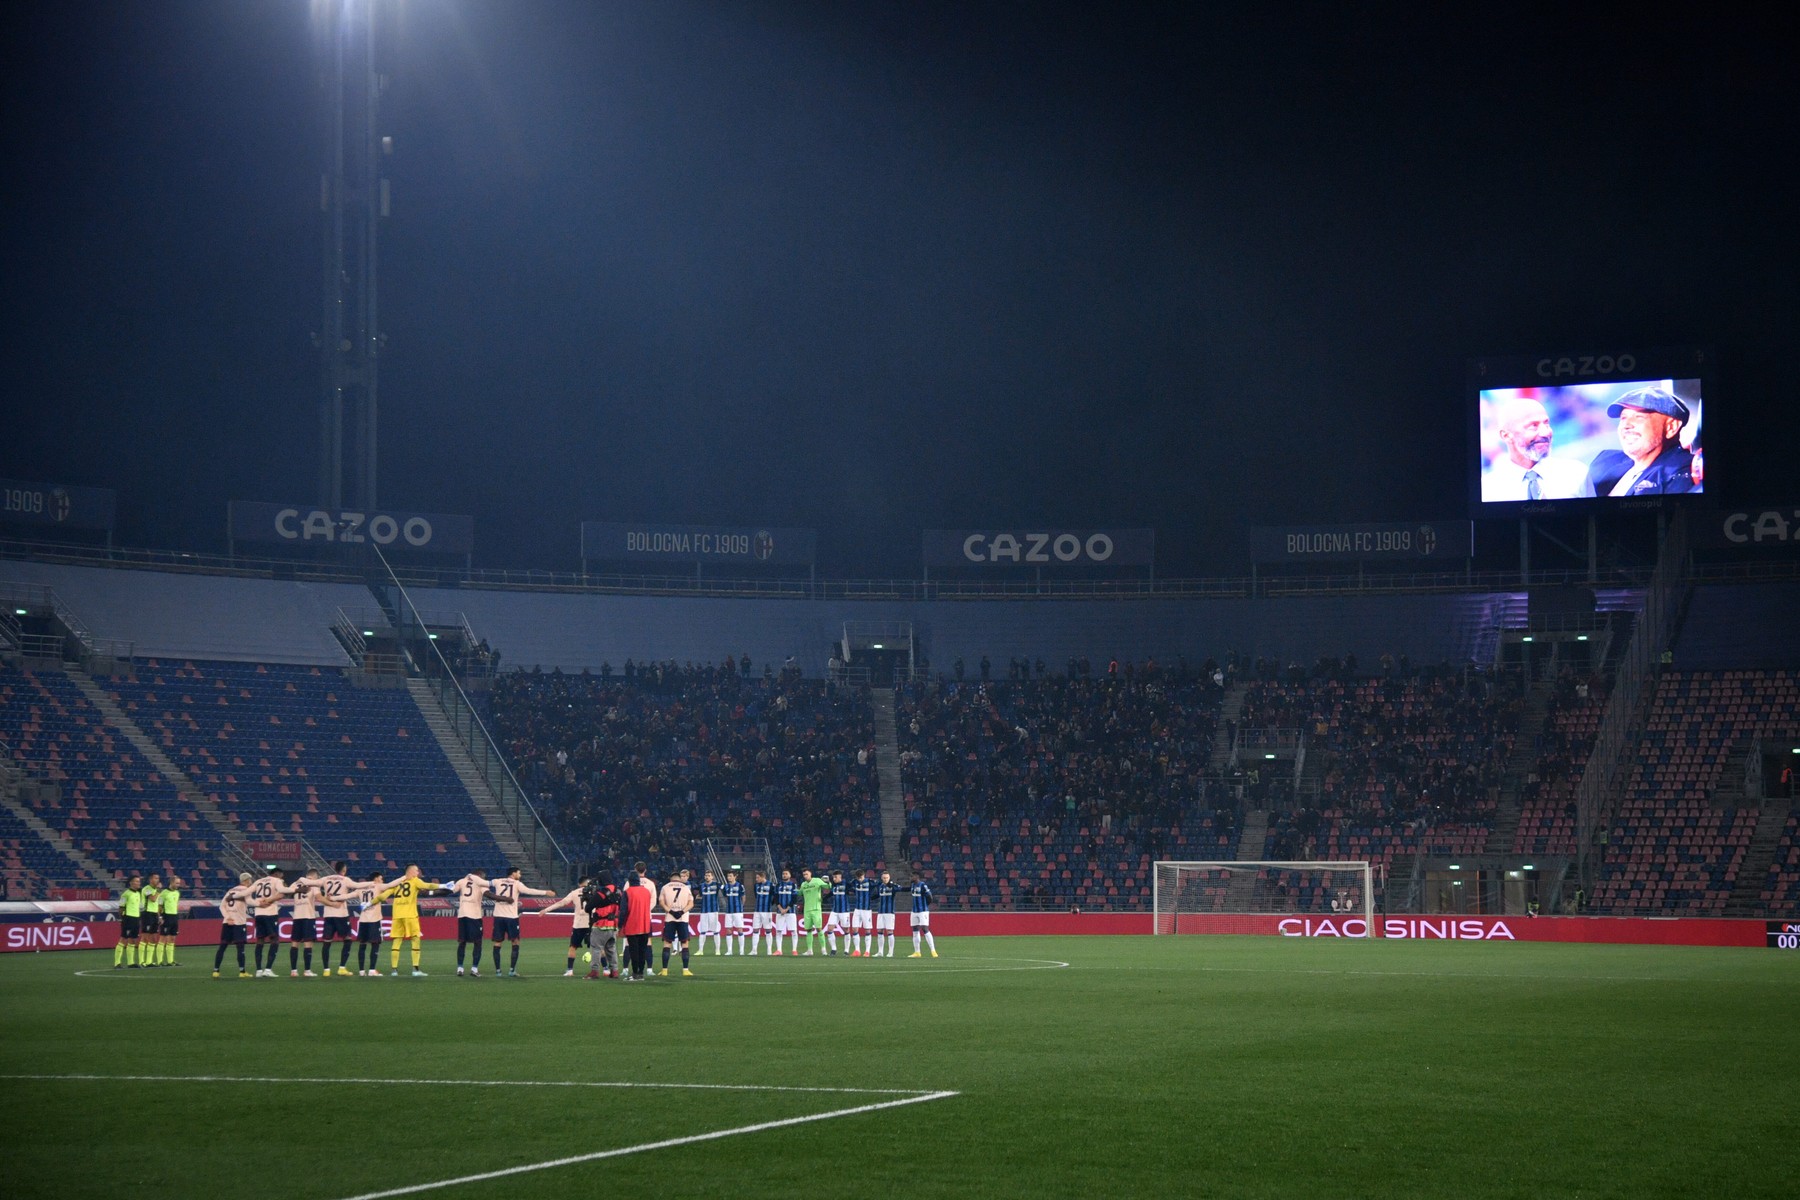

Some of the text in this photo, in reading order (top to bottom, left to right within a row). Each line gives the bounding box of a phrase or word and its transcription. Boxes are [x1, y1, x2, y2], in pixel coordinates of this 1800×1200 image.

[1536, 354, 1636, 377] CAZOO
[4, 488, 43, 513] 1909
[275, 509, 432, 546] CAZOO
[1723, 510, 1800, 542] CA
[627, 532, 749, 554] BOLOGNA FC 1909
[963, 533, 1114, 562] CAZOO
[1287, 531, 1411, 553] BOLOGNA FC 1909
[257, 882, 272, 898] 26
[326, 880, 342, 896] 22
[394, 882, 411, 898] 28
[464, 881, 474, 897] 5
[500, 883, 514, 898] 21
[673, 888, 681, 903] 7
[7, 925, 94, 948] SINISA
[1278, 919, 1516, 940] CIAO SINISA
